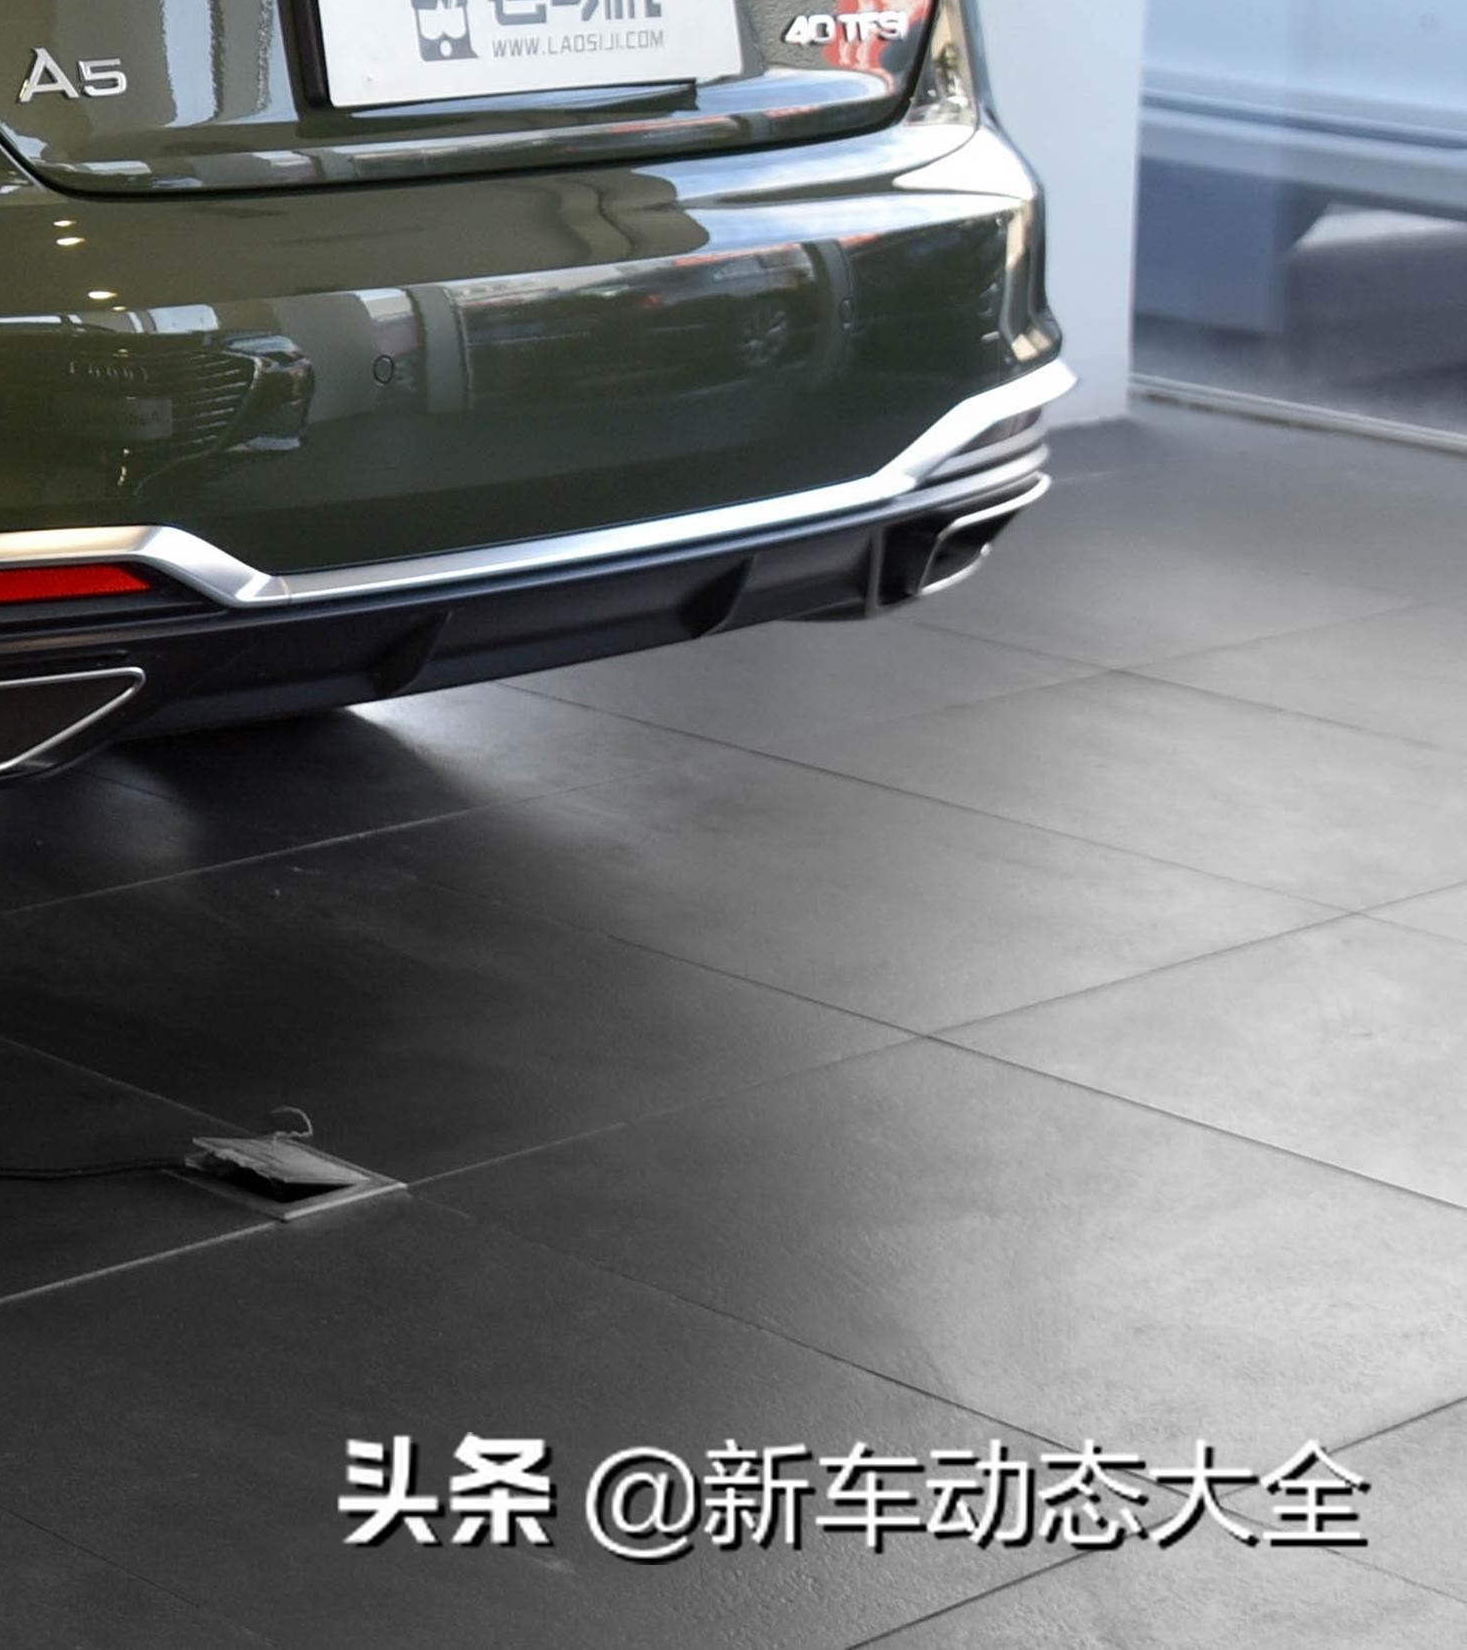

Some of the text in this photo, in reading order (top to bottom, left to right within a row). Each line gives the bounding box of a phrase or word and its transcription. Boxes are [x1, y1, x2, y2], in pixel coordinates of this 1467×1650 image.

[492, 29, 664, 58] WWW.LAOSIJI.COM
[781, 10, 909, 45] 40 TFSI
[18, 47, 127, 103] A5
